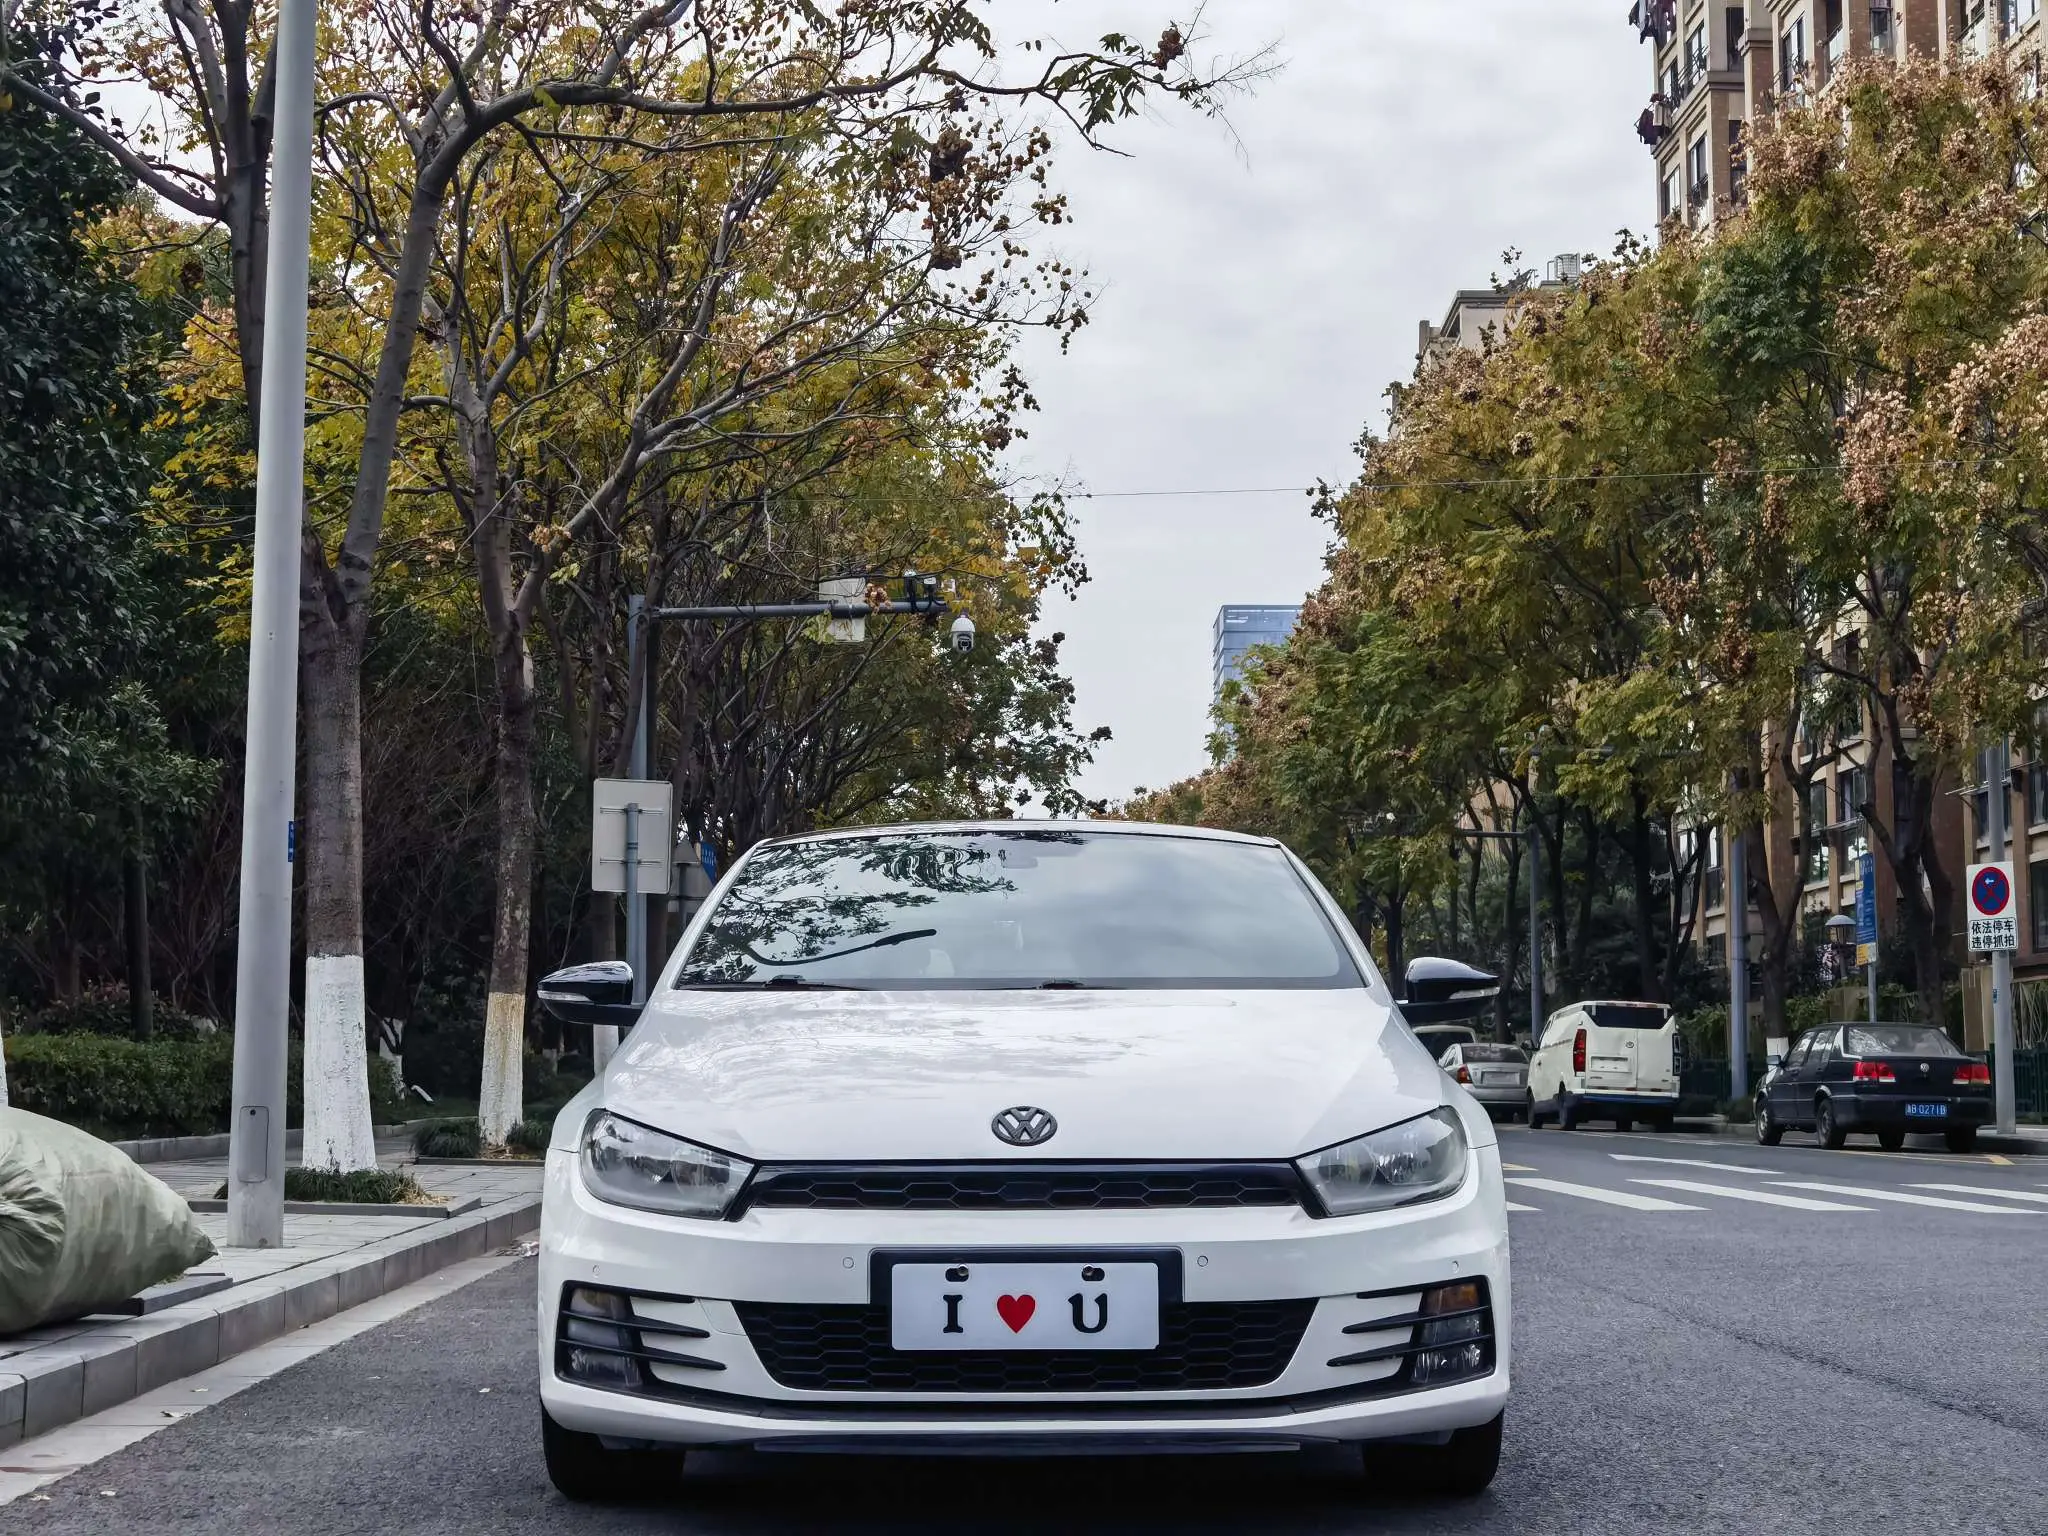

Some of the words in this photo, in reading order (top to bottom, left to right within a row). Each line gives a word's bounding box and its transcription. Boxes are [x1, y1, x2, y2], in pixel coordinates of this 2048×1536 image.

[1971, 920, 2014, 934] 依法停车
[1971, 934, 2015, 948] 违停抓拍
[942, 1294, 964, 1334] I
[1067, 1292, 1108, 1334] U
